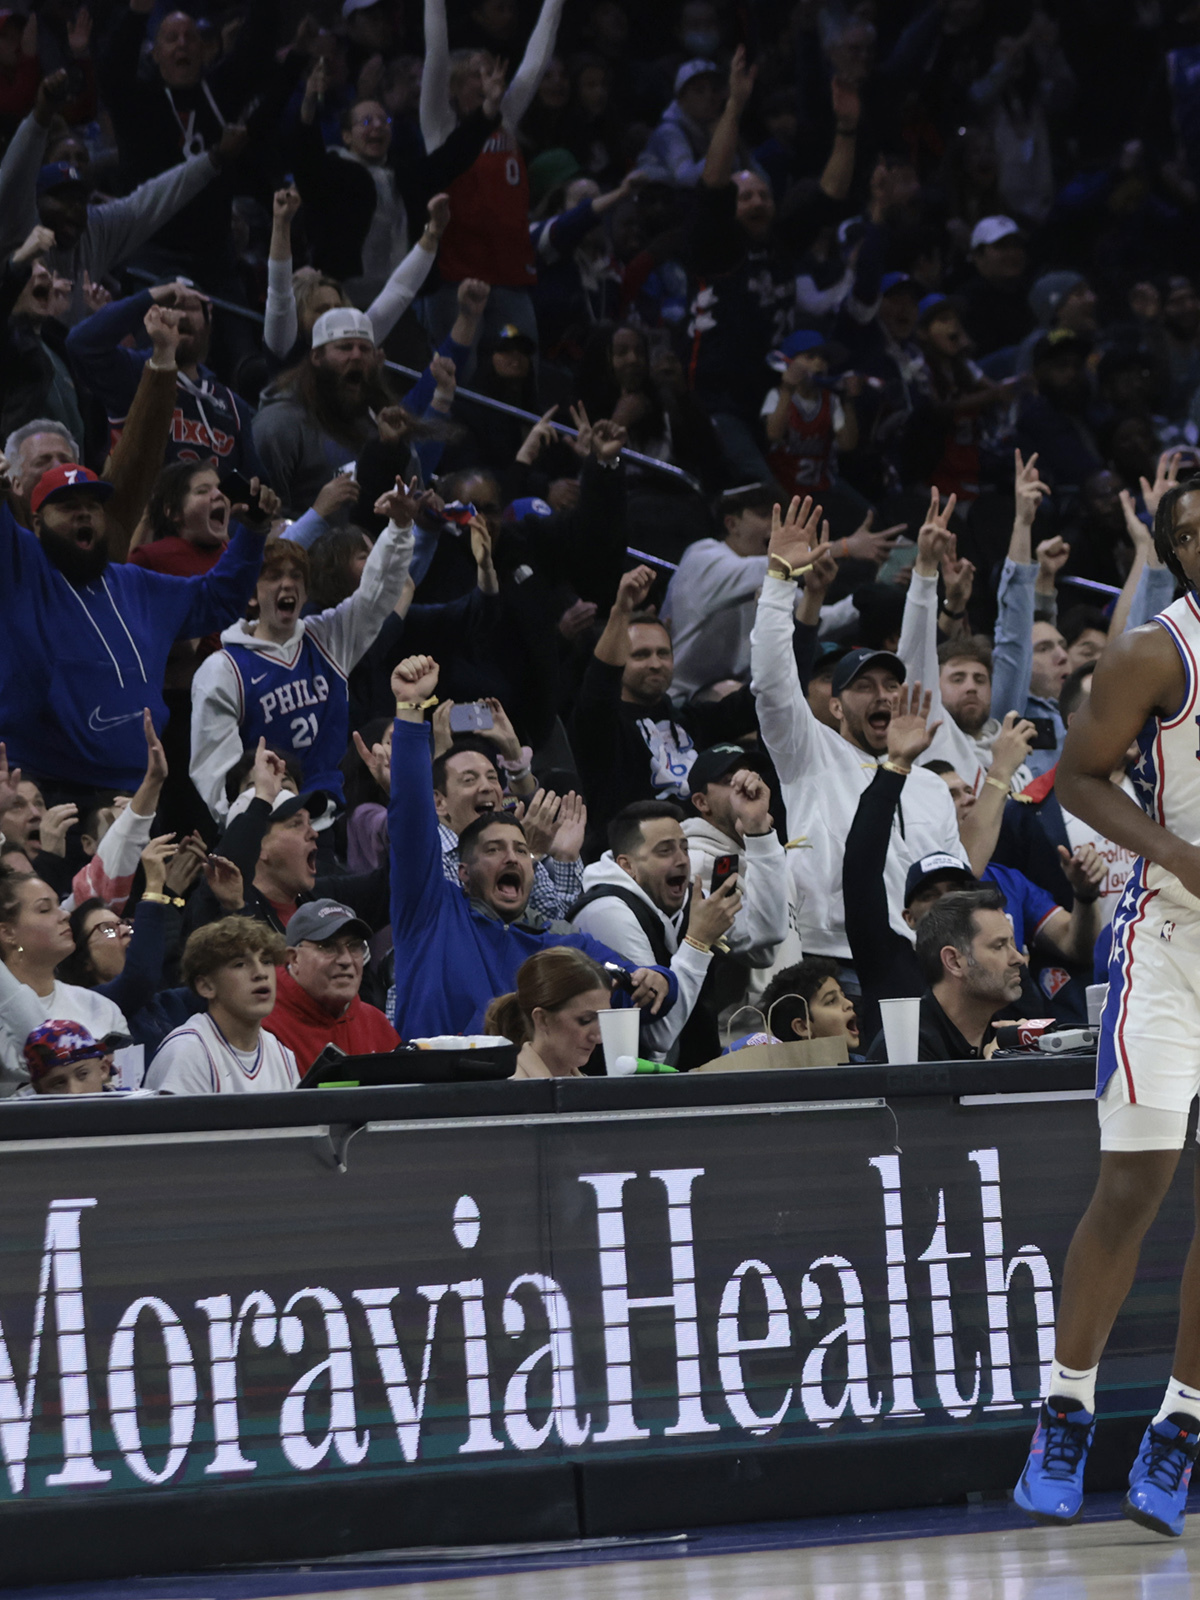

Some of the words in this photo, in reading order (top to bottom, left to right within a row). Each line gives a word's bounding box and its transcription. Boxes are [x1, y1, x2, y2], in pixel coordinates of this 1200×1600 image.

[505, 156, 520, 186] 0
[169, 407, 235, 457] ixers
[259, 674, 329, 724] PHILA
